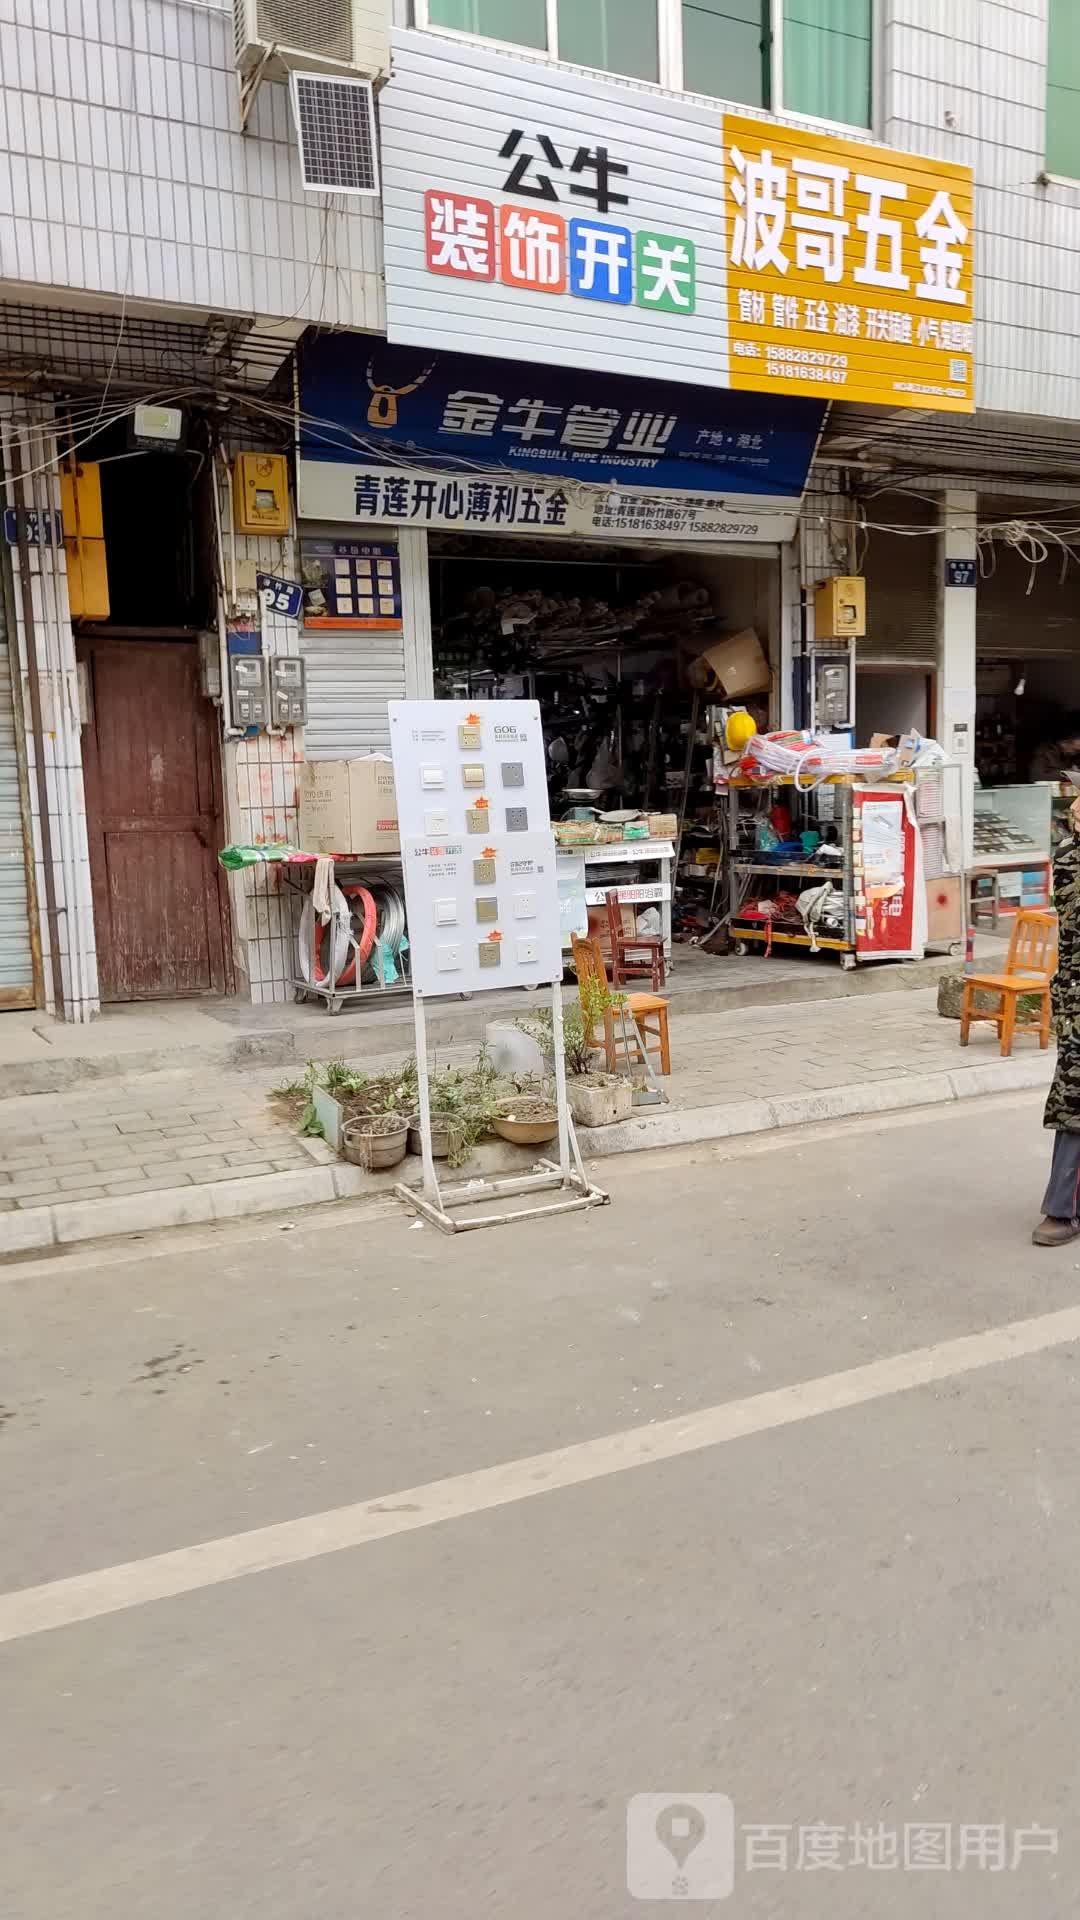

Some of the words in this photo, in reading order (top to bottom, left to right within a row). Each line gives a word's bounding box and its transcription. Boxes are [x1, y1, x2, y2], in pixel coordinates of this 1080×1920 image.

[498, 128, 629, 213] 公牛
[728, 144, 968, 305] 波哥五金
[430, 197, 690, 304] 装饰开关
[738, 287, 766, 324] 管材
[771, 293, 799, 329] 管件
[804, 299, 830, 333] 五金
[833, 303, 861, 337] 油漆
[865, 308, 913, 344] 开关插座
[765, 346, 849, 367] 15882829729
[765, 363, 849, 385] 15181638497
[437, 389, 679, 455] 金牛管业
[508, 446, 569, 462] KINGBULL
[571, 452, 599, 464] PIPE
[601, 455, 660, 469] INDUSTRY
[353, 474, 569, 526] 青莲开心薄利五金
[689, 522, 759, 535] 15882829729
[954, 570, 970, 583] 97
[263, 588, 290, 611] 95
